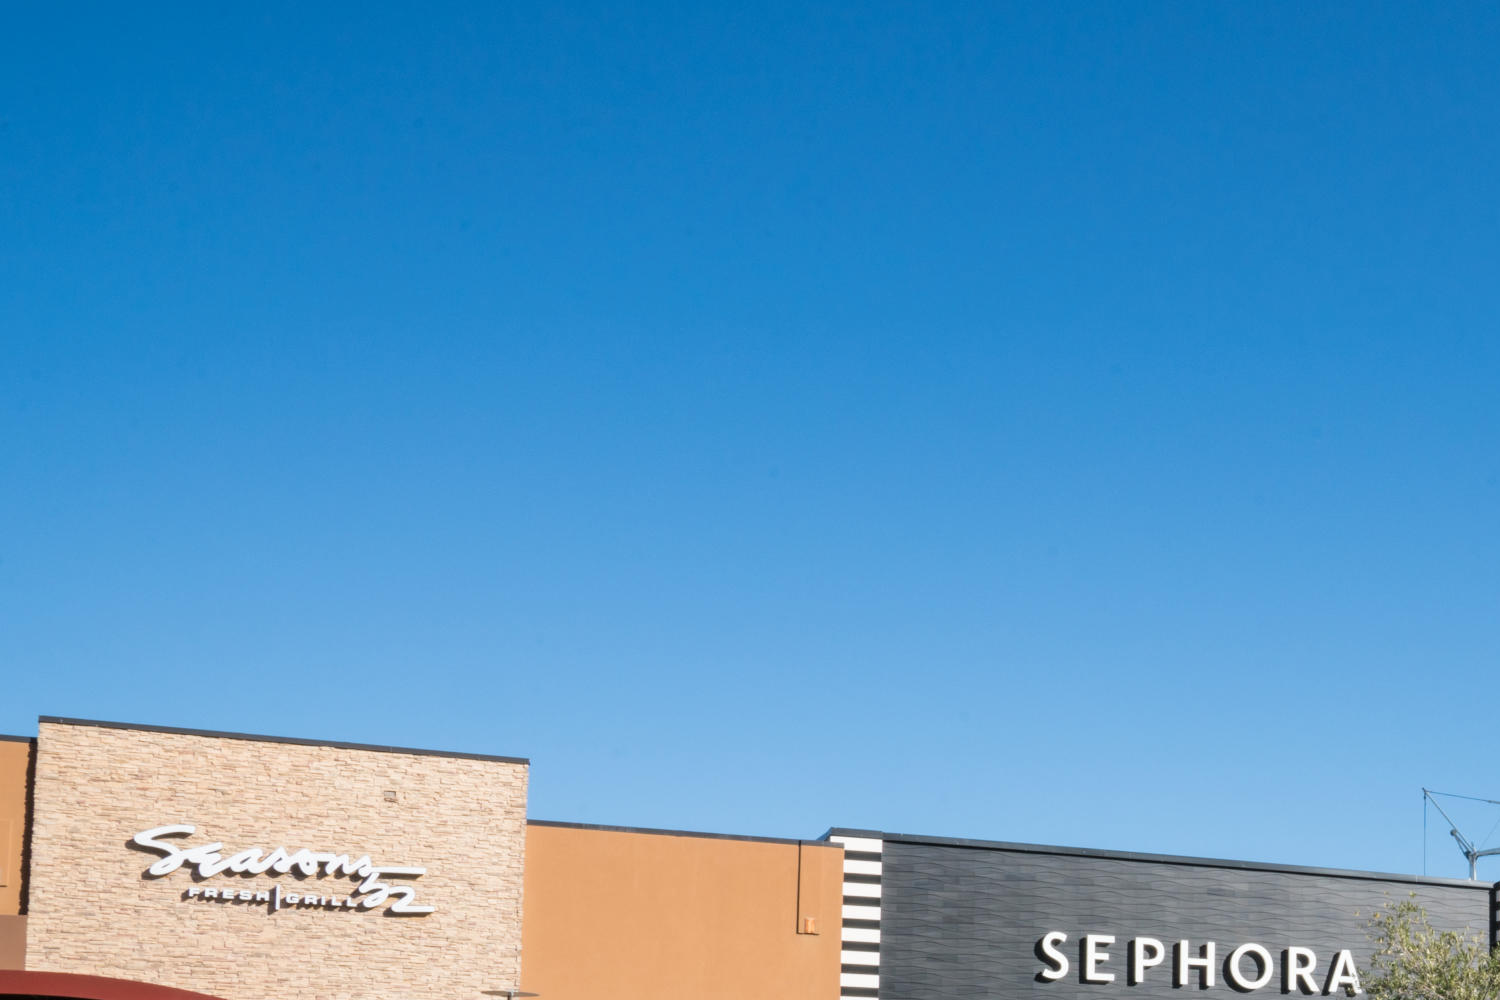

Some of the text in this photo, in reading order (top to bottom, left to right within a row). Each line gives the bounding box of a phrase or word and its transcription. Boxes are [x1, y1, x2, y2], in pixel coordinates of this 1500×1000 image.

[133, 824, 436, 913] Seasons 52
[188, 886, 358, 908] FRESH GRILL
[1041, 930, 1363, 995] SEPHORA
